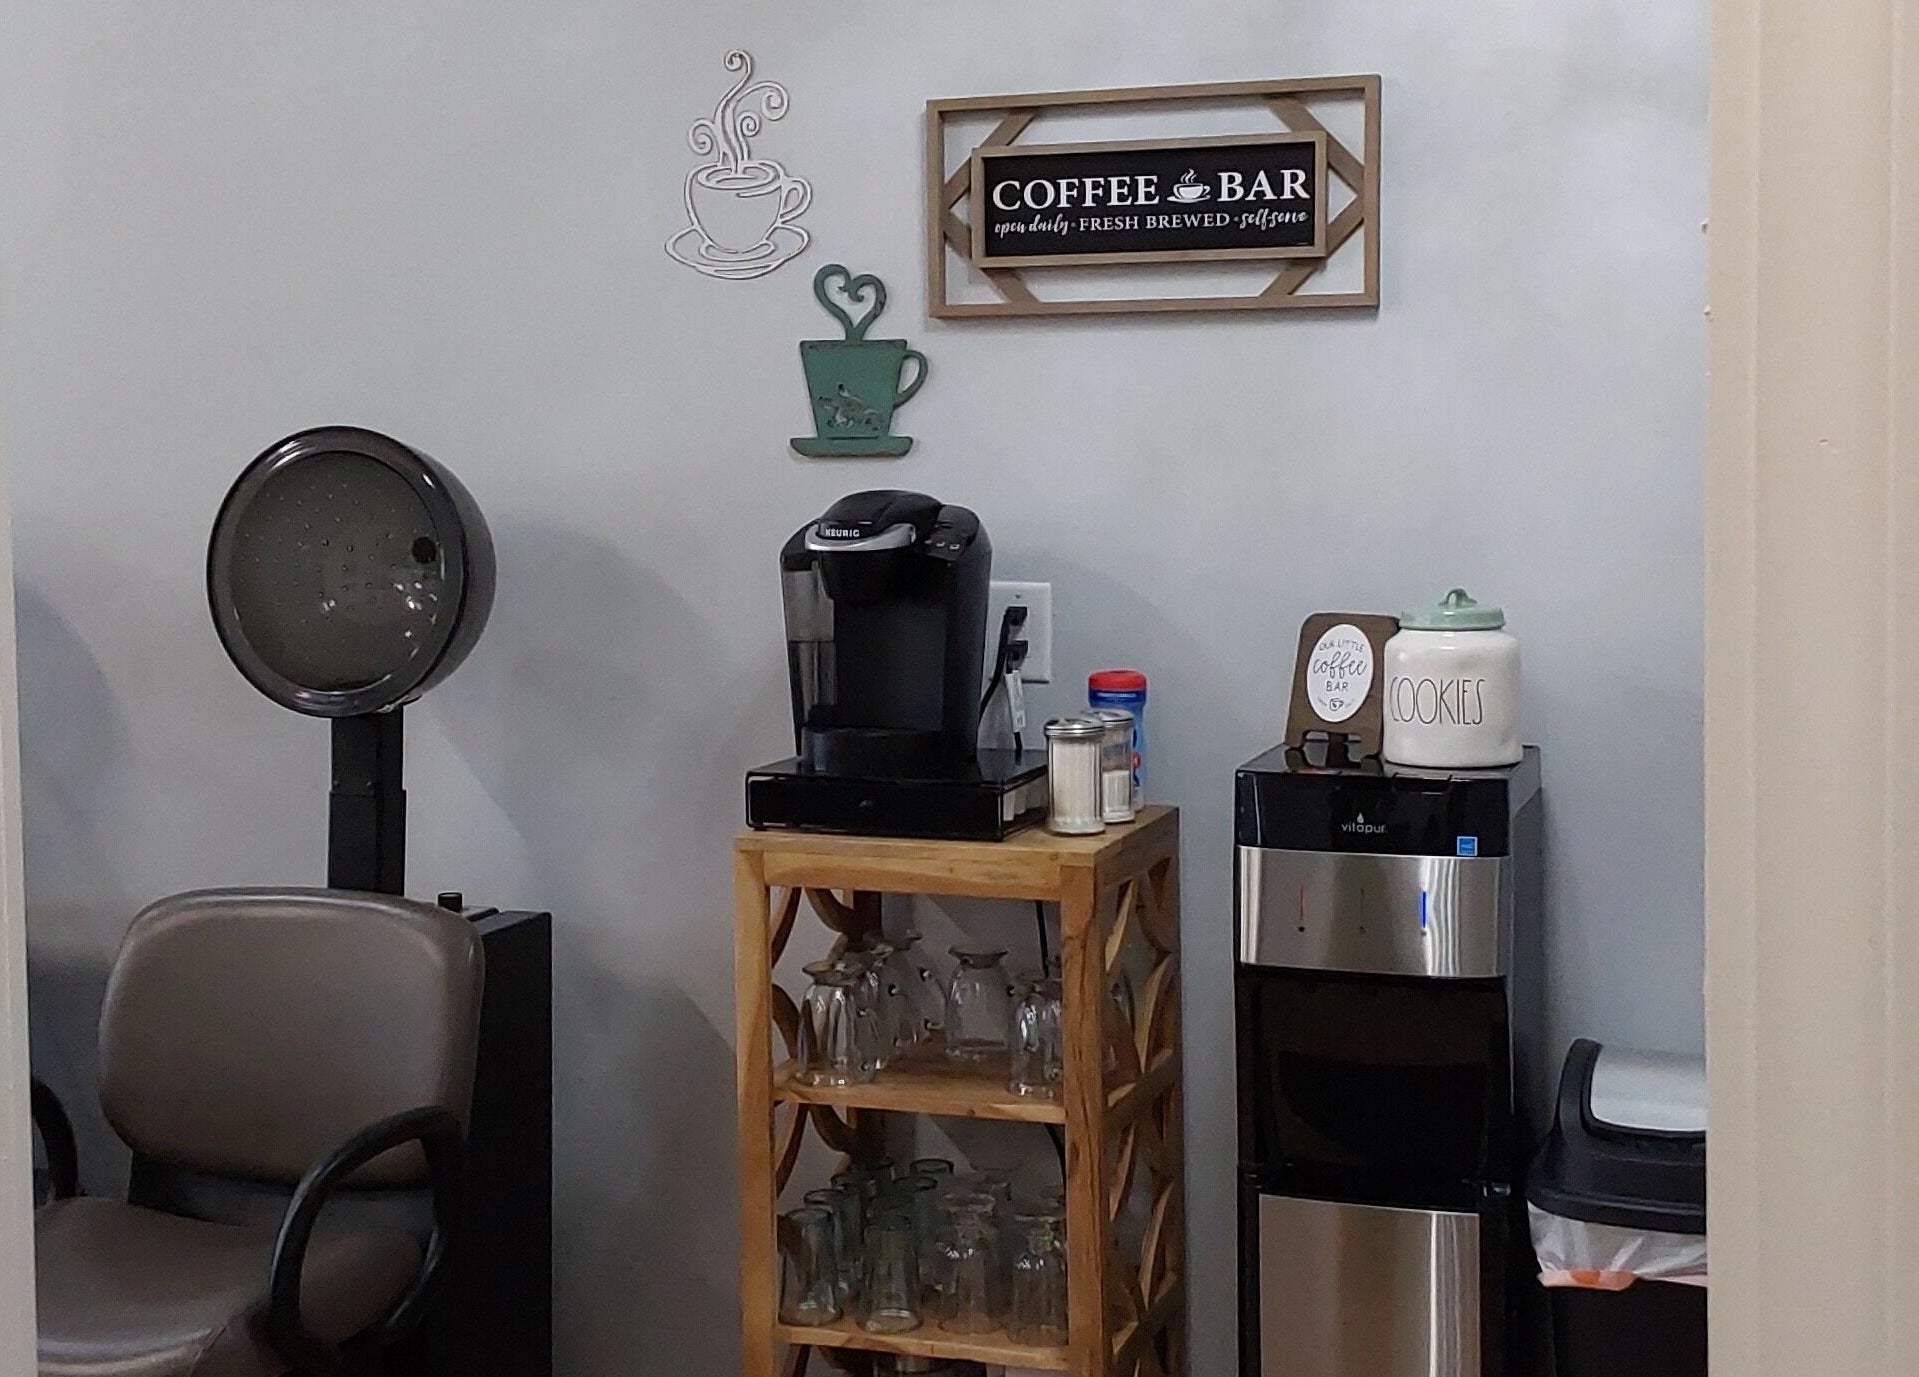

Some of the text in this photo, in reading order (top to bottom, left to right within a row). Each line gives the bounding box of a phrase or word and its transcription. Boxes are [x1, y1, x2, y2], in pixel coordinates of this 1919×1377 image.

[992, 168, 1312, 211] COFFEE BAR
[994, 221, 1027, 239] open
[1028, 213, 1069, 236] daily
[1079, 216, 1139, 231] FRESH
[1145, 213, 1231, 229] BREWED
[825, 528, 860, 538] KEURIG
[1337, 640, 1366, 653] LITTLE
[1313, 651, 1368, 680] coffee
[1326, 680, 1349, 692] BAR
[1389, 676, 1486, 726] COOKIES
